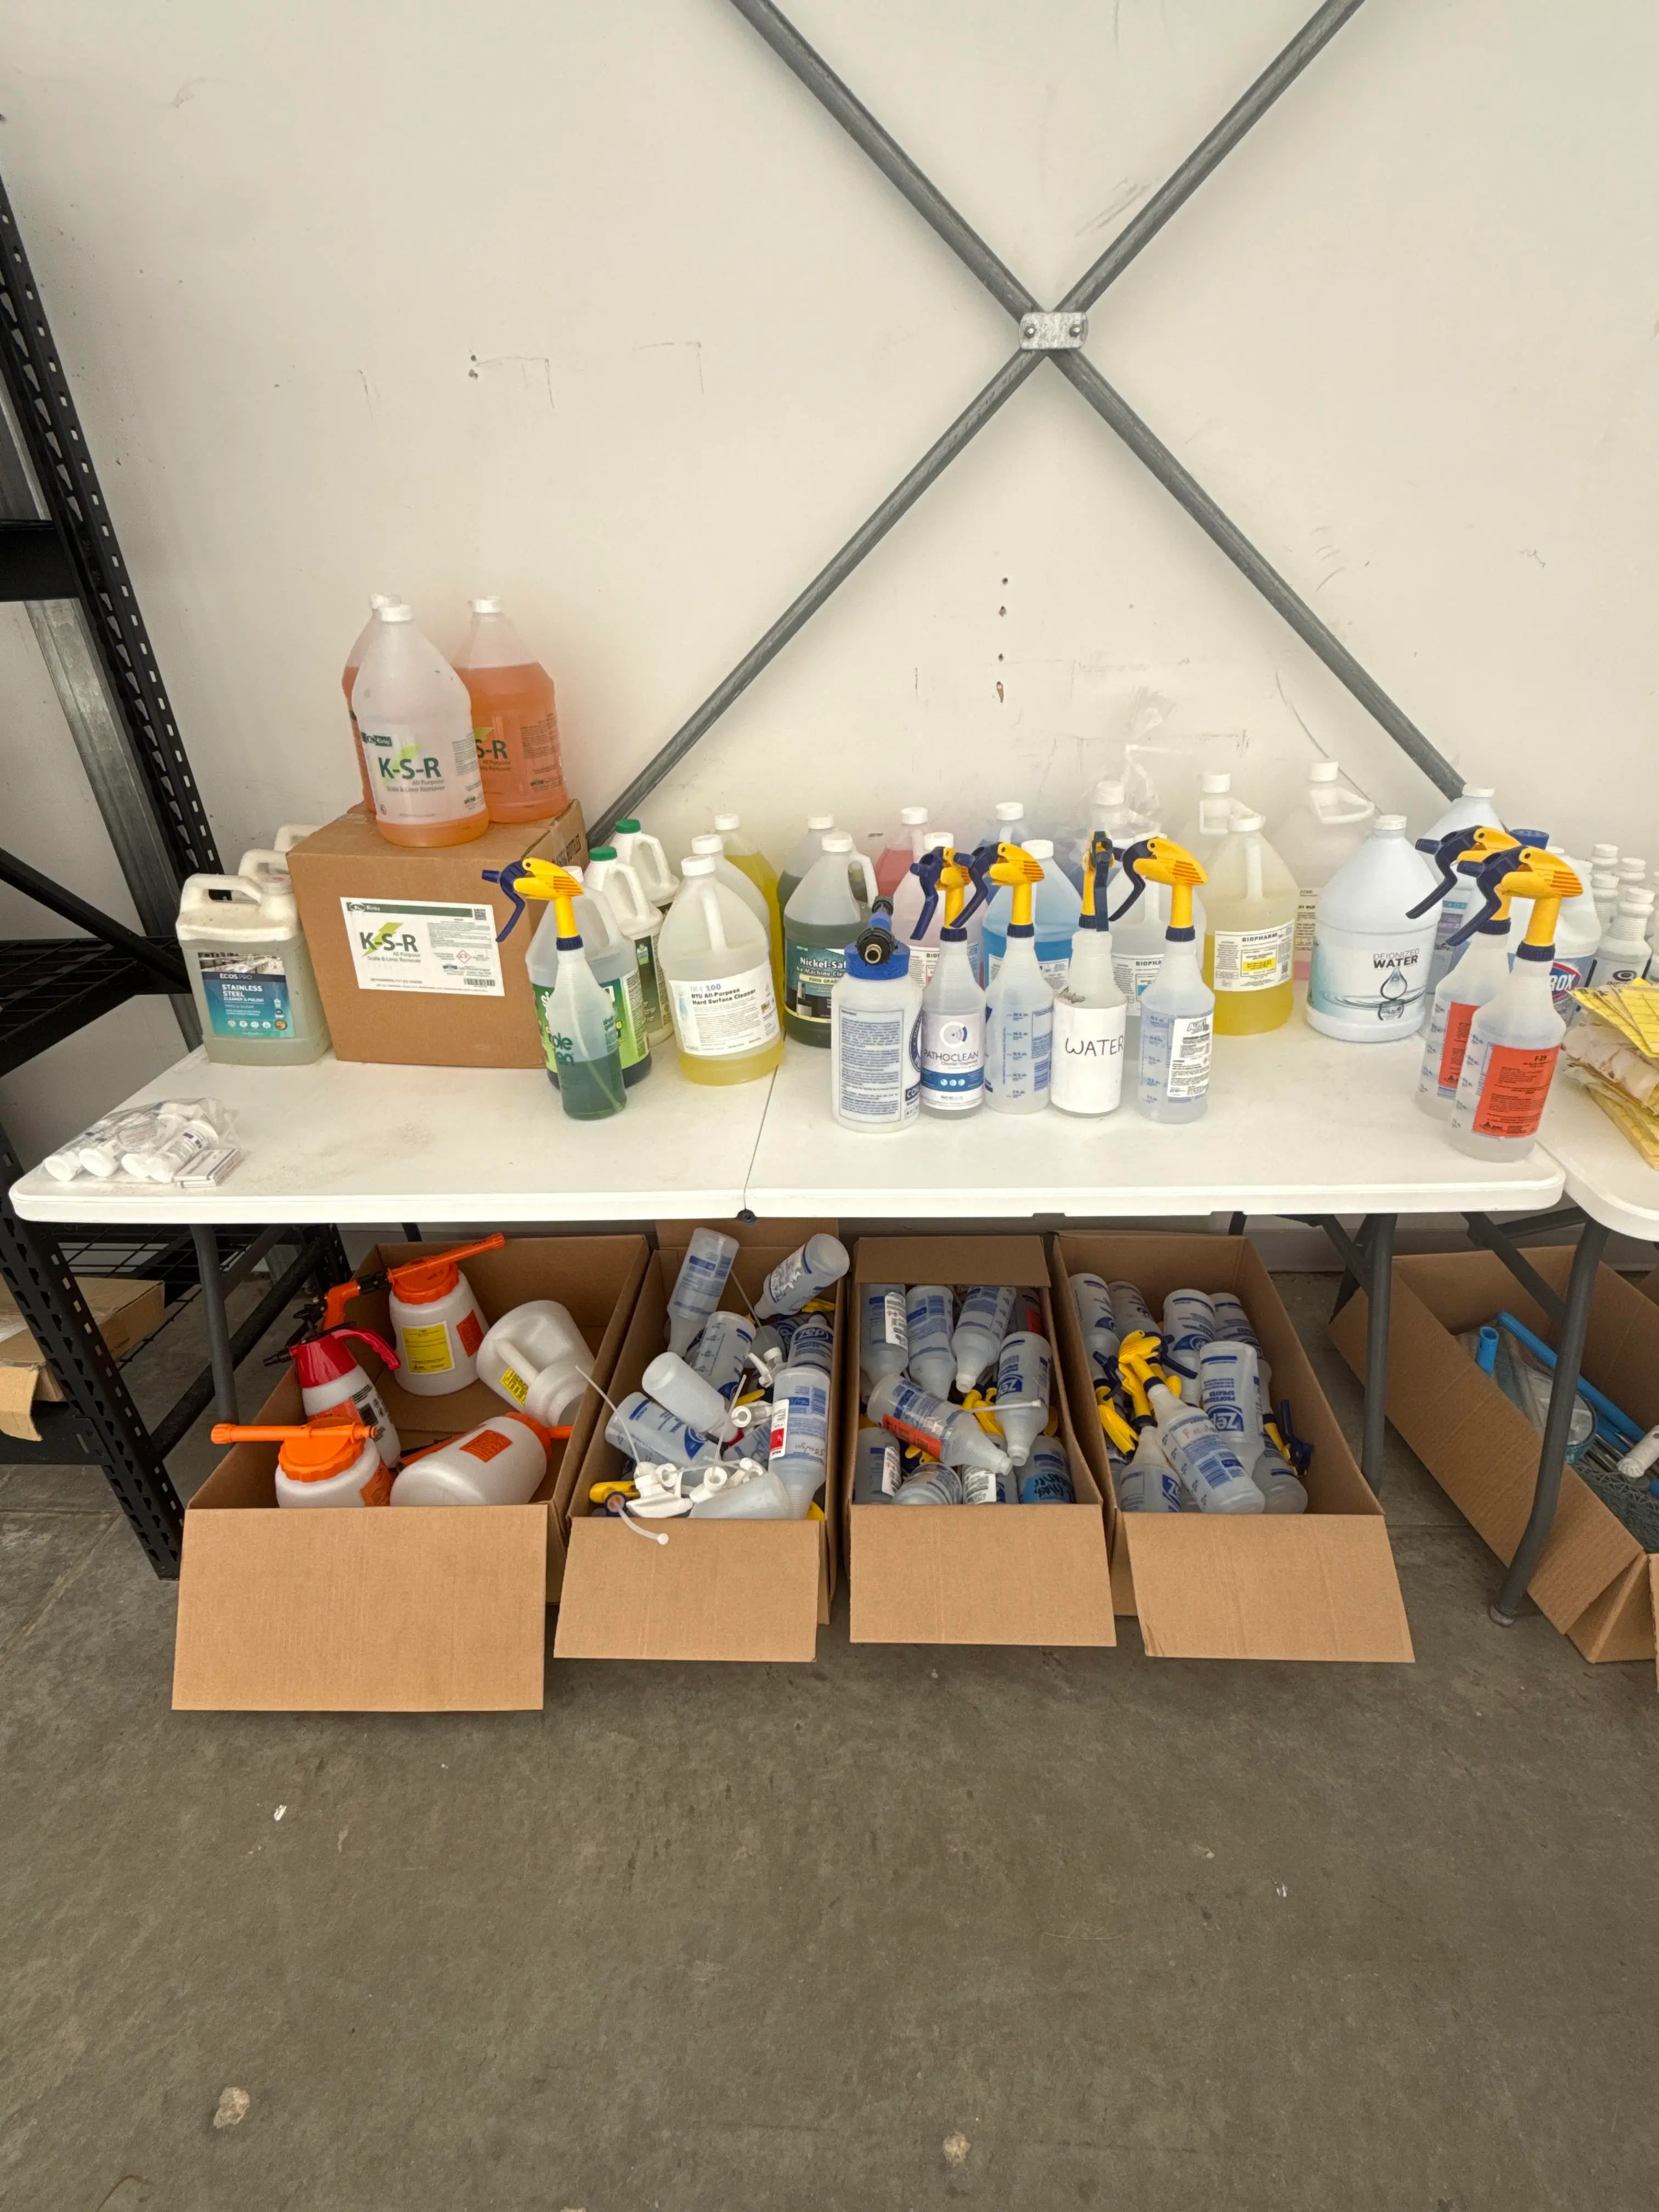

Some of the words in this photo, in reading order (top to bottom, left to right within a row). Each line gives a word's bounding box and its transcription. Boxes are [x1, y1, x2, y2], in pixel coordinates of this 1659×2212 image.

[475, 739, 508, 759] S-R
[379, 757, 442, 780] K-S-R
[359, 932, 419, 952] K-S-R
[1242, 933, 1278, 943] BIOPHARM
[1373, 948, 1420, 960] DEIONIZED
[799, 956, 847, 969] Nickel-Saf
[1373, 955, 1419, 968] WATER
[805, 967, 831, 977] Machine
[222, 984, 263, 992] STAINLESS
[706, 984, 721, 992] 100
[1549, 973, 1576, 992] ROX
[704, 988, 741, 998] All-Purpose
[708, 996, 733, 1005] Surface
[734, 989, 757, 1000] Cleaner
[1065, 1034, 1124, 1057] WATER
[924, 1048, 979, 1062] PATHOCLEAN
[999, 1379, 1018, 1395] Ze
